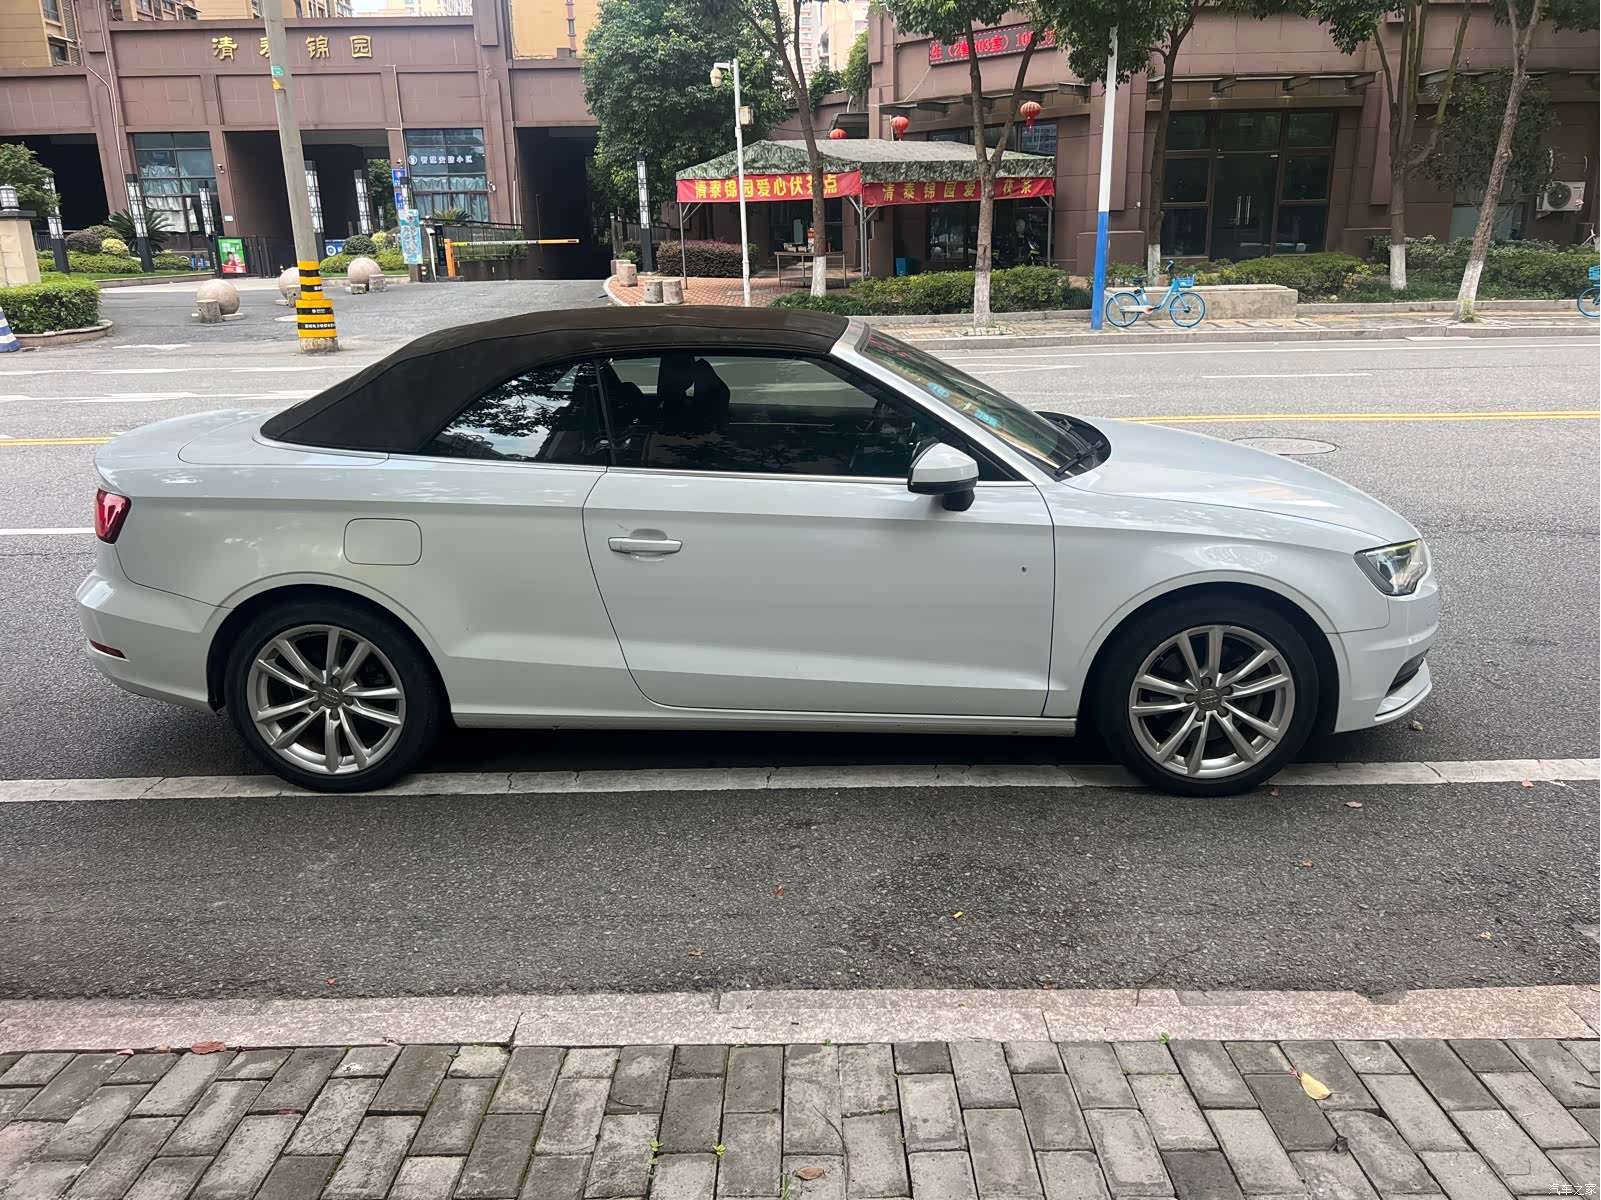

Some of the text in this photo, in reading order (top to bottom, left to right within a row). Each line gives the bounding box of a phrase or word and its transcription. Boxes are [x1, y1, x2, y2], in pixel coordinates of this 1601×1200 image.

[882, 178, 1033, 201] 清泰锦园爱茯茶
